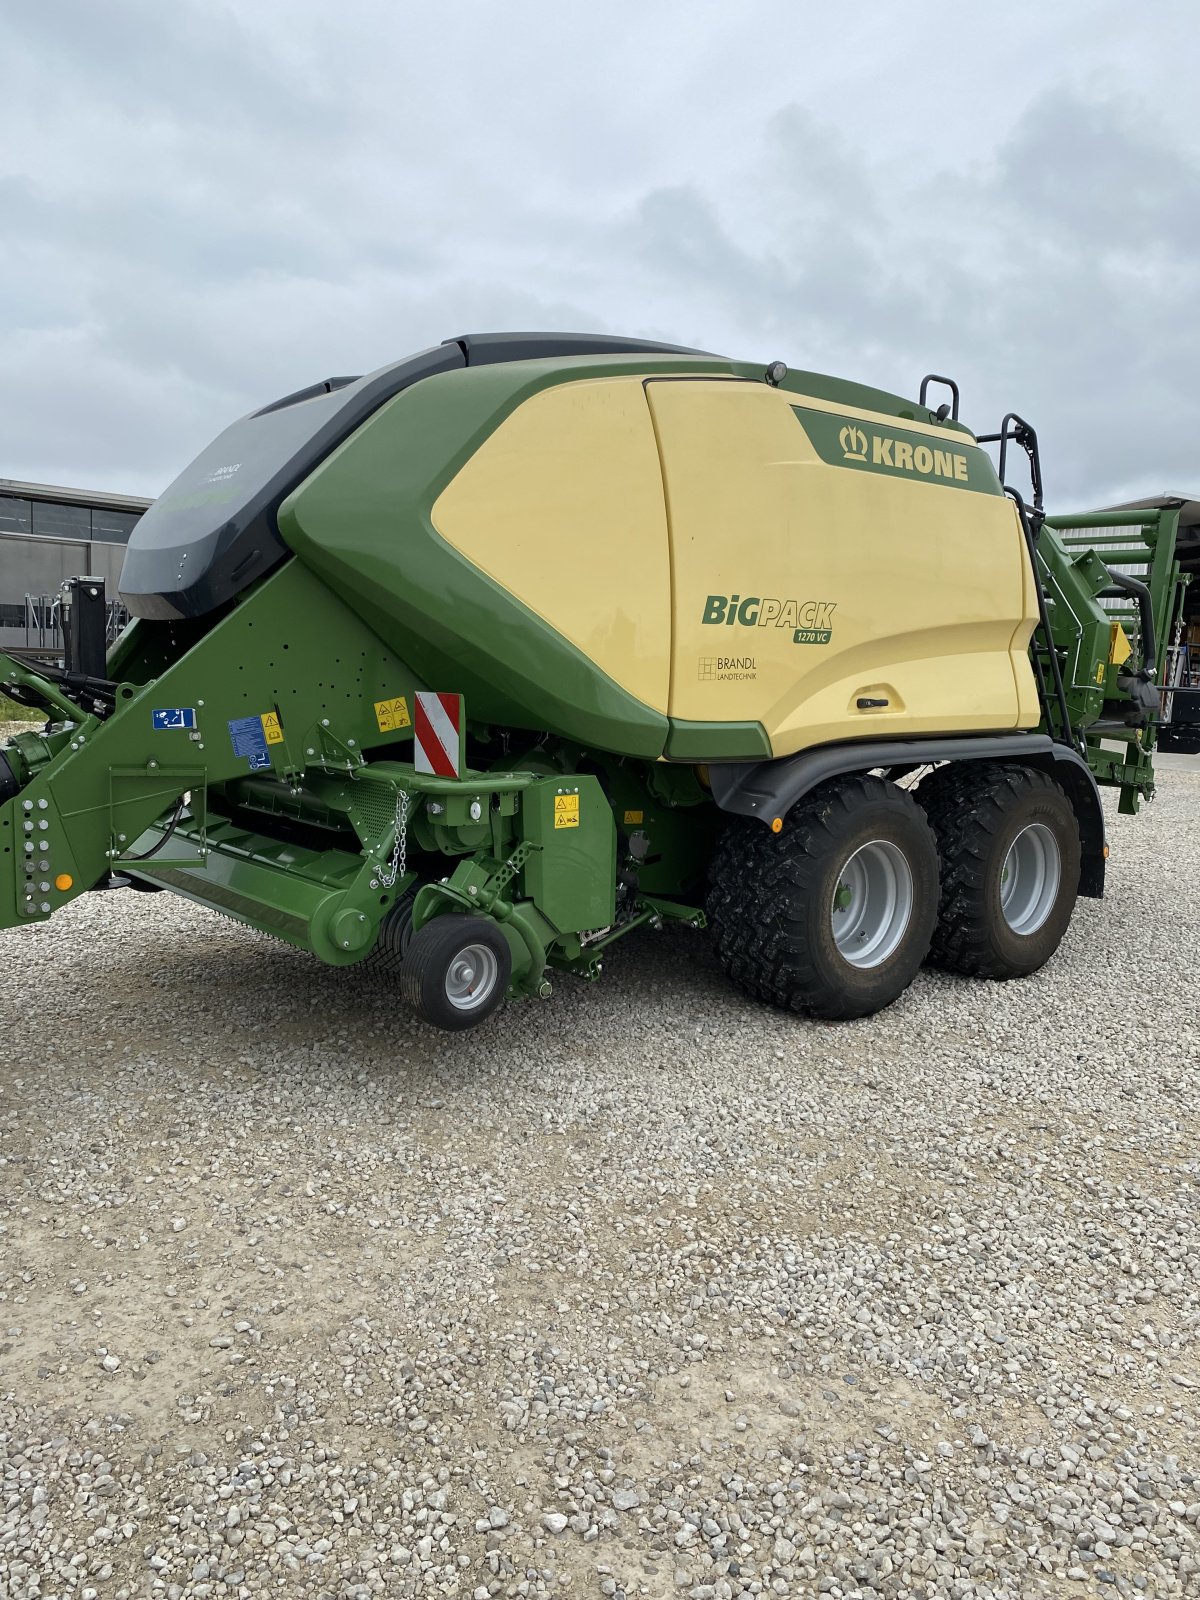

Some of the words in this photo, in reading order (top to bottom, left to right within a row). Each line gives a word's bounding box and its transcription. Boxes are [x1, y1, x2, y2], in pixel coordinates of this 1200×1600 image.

[872, 435, 969, 482] KRONE
[798, 632, 815, 642] 1270
[817, 632, 828, 642] VC
[717, 657, 757, 670] BRANDL
[717, 672, 757, 681] LANDTECHNIK
